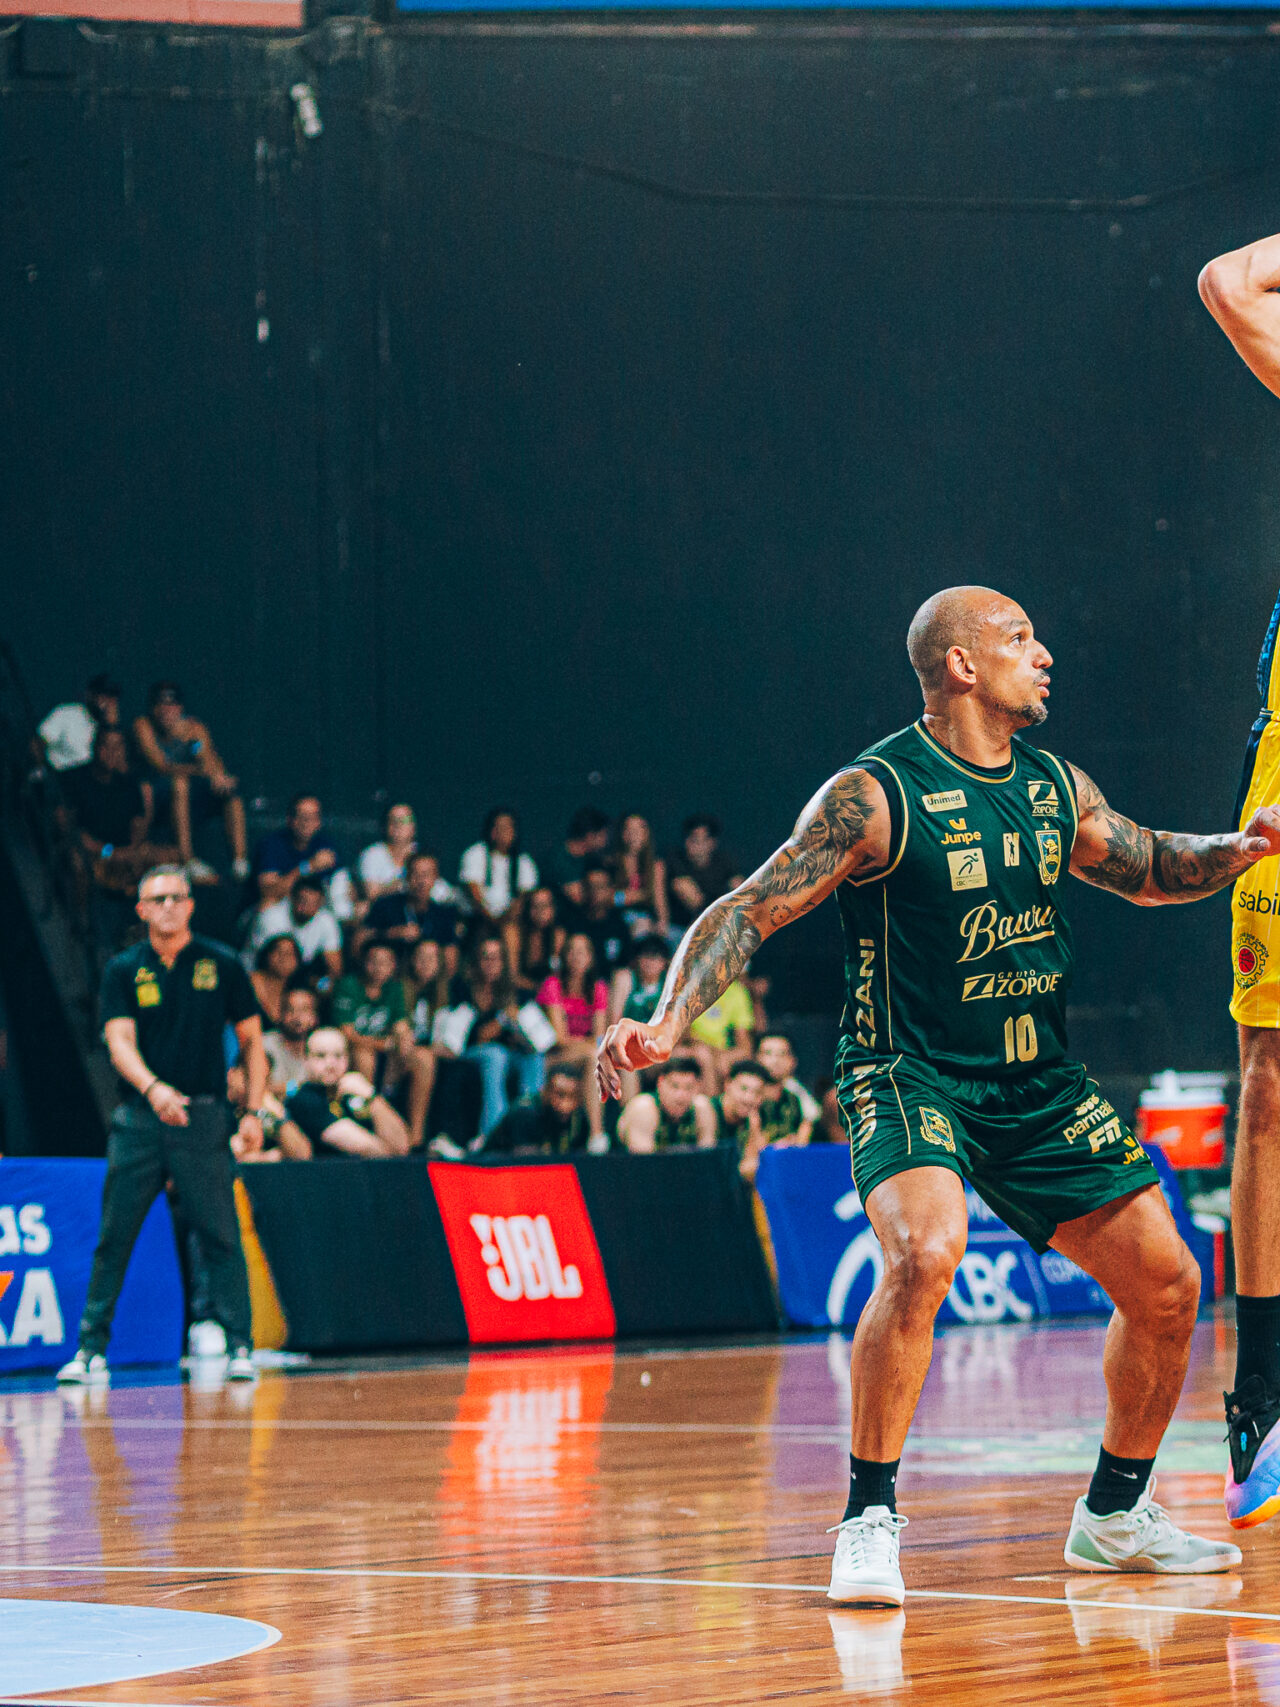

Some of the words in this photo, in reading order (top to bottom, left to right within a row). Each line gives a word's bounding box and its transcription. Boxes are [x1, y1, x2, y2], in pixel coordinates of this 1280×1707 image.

[926, 794, 961, 806] Unimed
[941, 831, 982, 845] Junpe
[1004, 1013, 1038, 1064] 10
[469, 1213, 584, 1301] JBL
